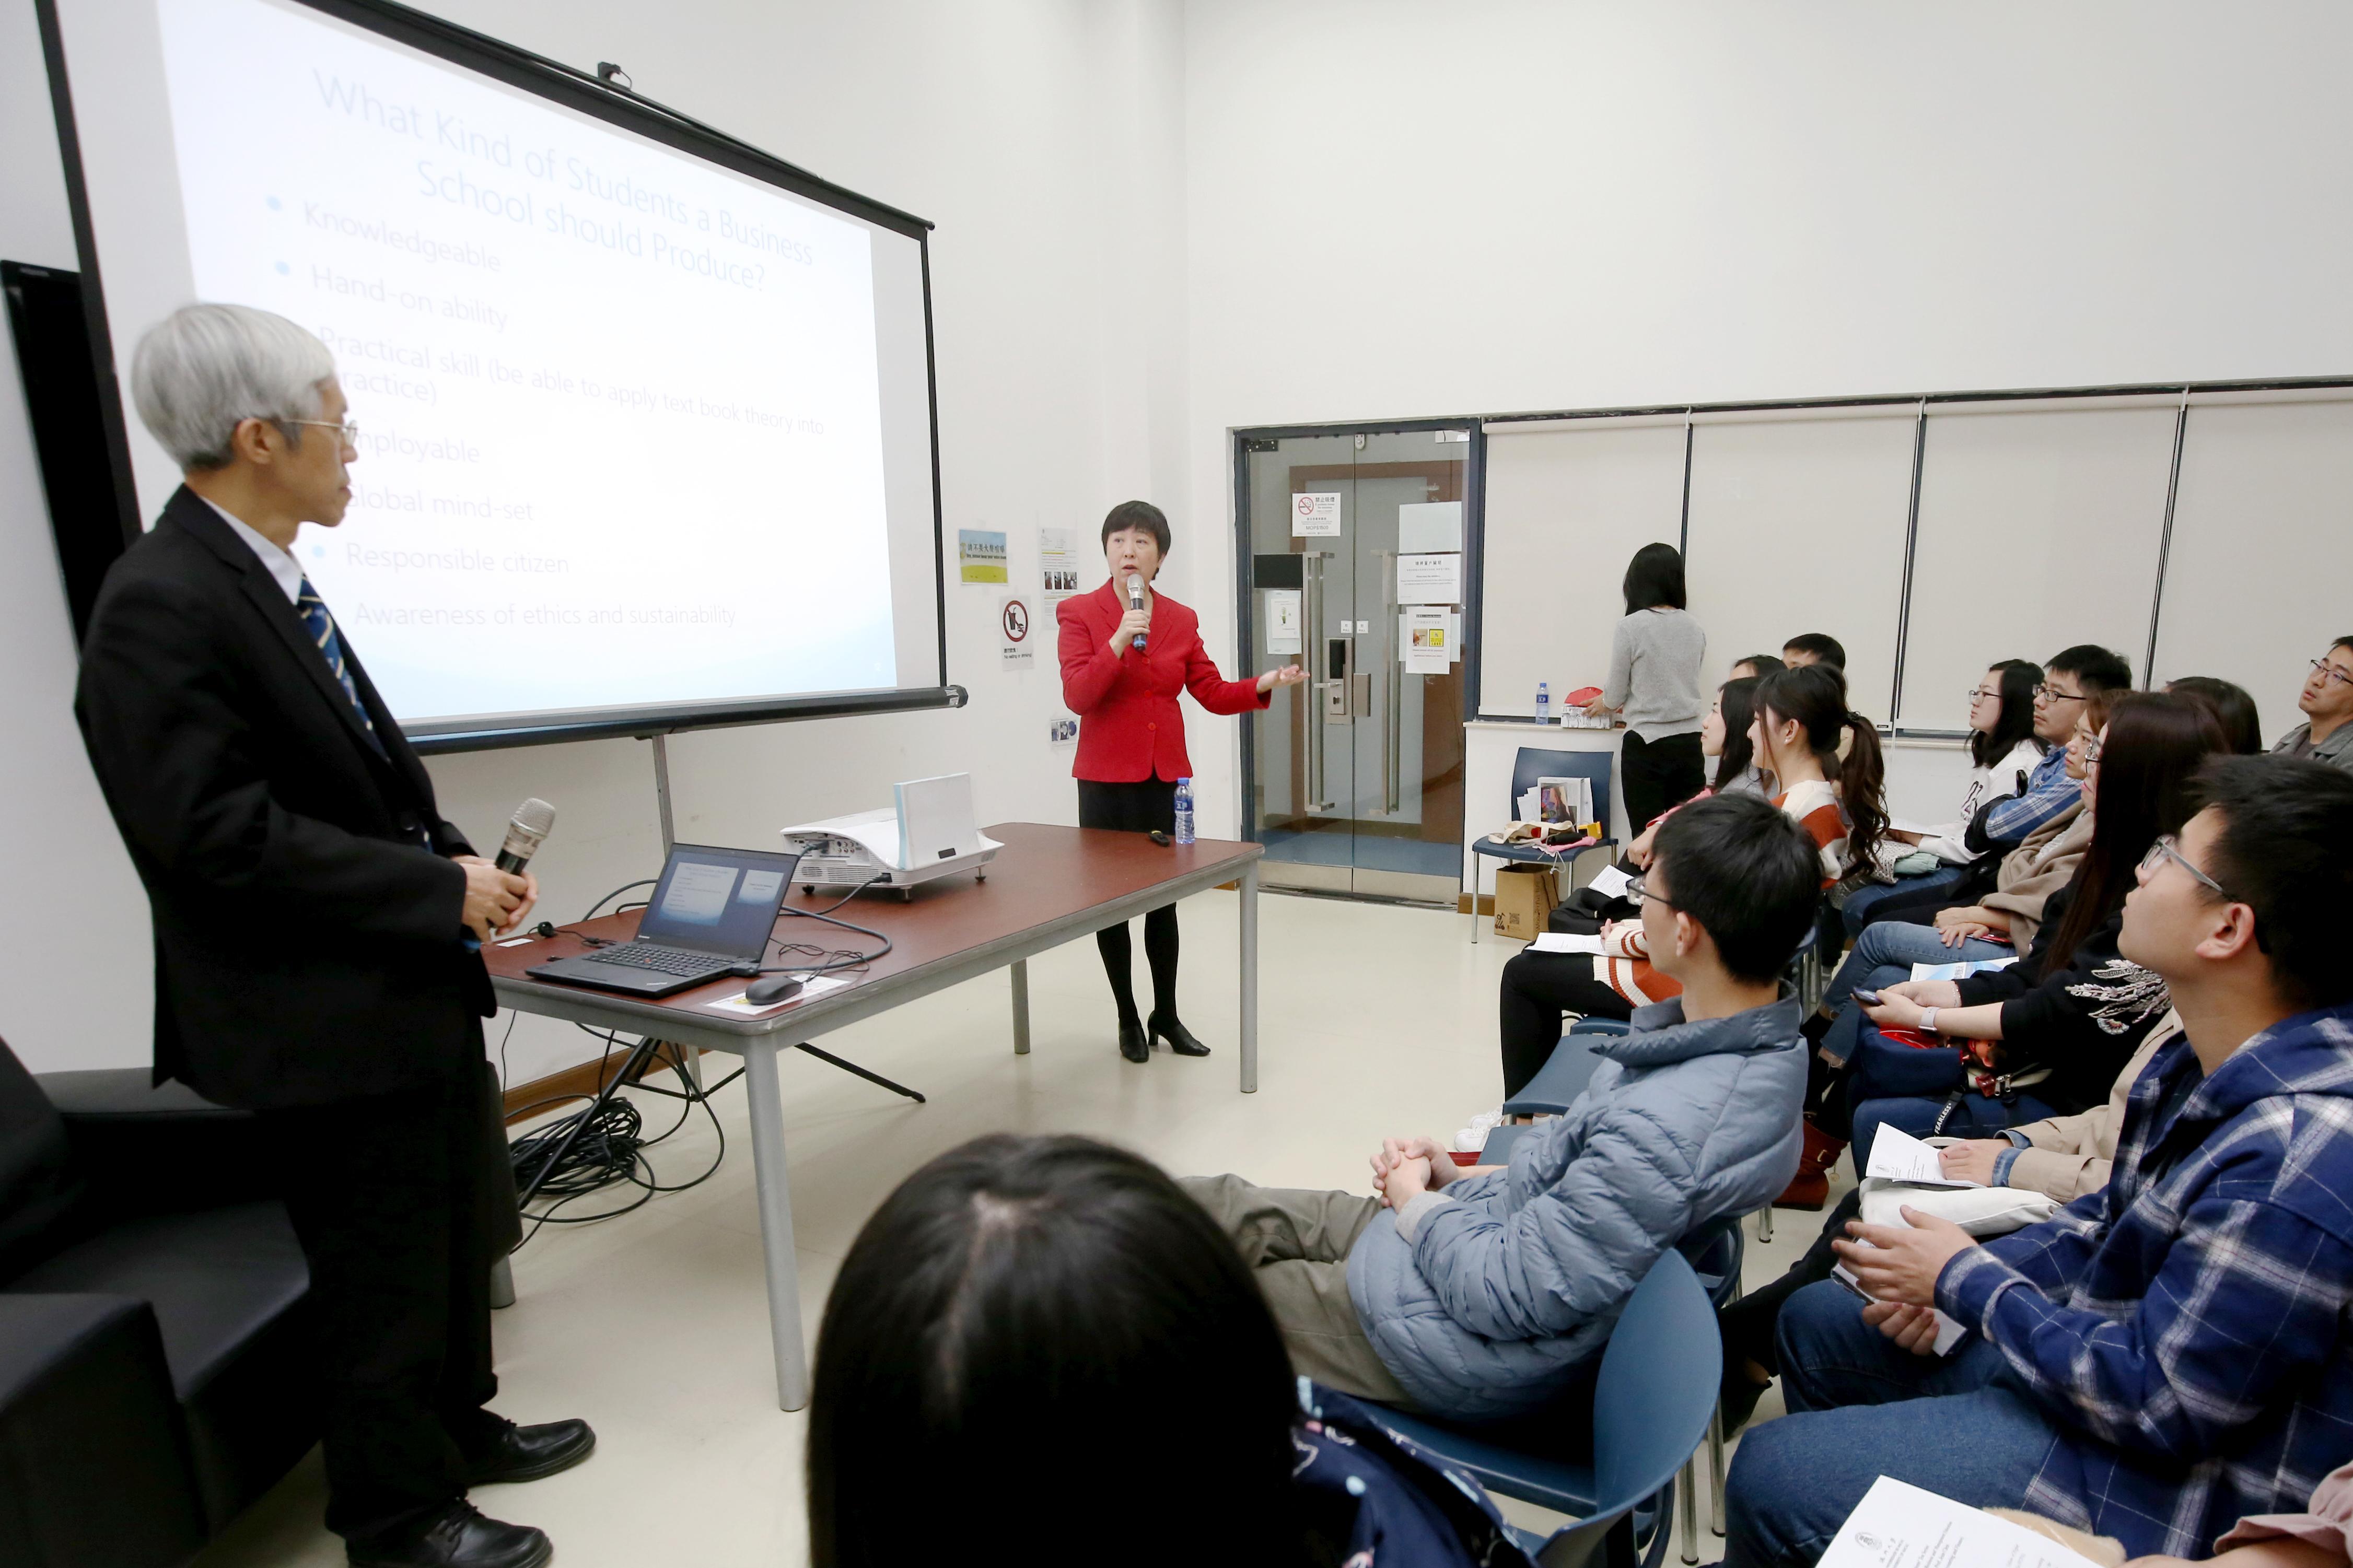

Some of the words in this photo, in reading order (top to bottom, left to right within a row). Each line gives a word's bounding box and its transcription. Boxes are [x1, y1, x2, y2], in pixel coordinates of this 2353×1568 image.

[312, 66, 424, 140] What
[435, 109, 511, 168] Kind
[525, 148, 556, 182] of
[567, 156, 688, 225] Students
[698, 209, 710, 231] a
[720, 209, 812, 266] Business
[302, 200, 502, 272] Knowledgeable
[417, 160, 533, 226] School
[545, 202, 643, 258] should
[653, 232, 765, 291] Produce?
[311, 263, 434, 313] Hand-on
[441, 294, 508, 334] ability
[319, 325, 431, 369] Practical
[439, 350, 480, 377] skill
[489, 357, 523, 385] (be
[531, 368, 574, 394] able
[580, 377, 601, 398] to
[608, 385, 657, 413] apply
[663, 392, 695, 414] text
[700, 397, 740, 422] book
[745, 406, 793, 435] theory
[797, 415, 824, 435] into
[341, 370, 438, 407] ractice)
[357, 428, 481, 464] mployable
[432, 494, 535, 521] mind-set
[346, 543, 495, 573] Responsible
[503, 551, 569, 574] citizen
[357, 602, 486, 626] Awareness
[494, 603, 517, 625] of
[523, 603, 581, 625] ethics
[588, 605, 623, 625] and
[630, 604, 736, 628] sustainability
